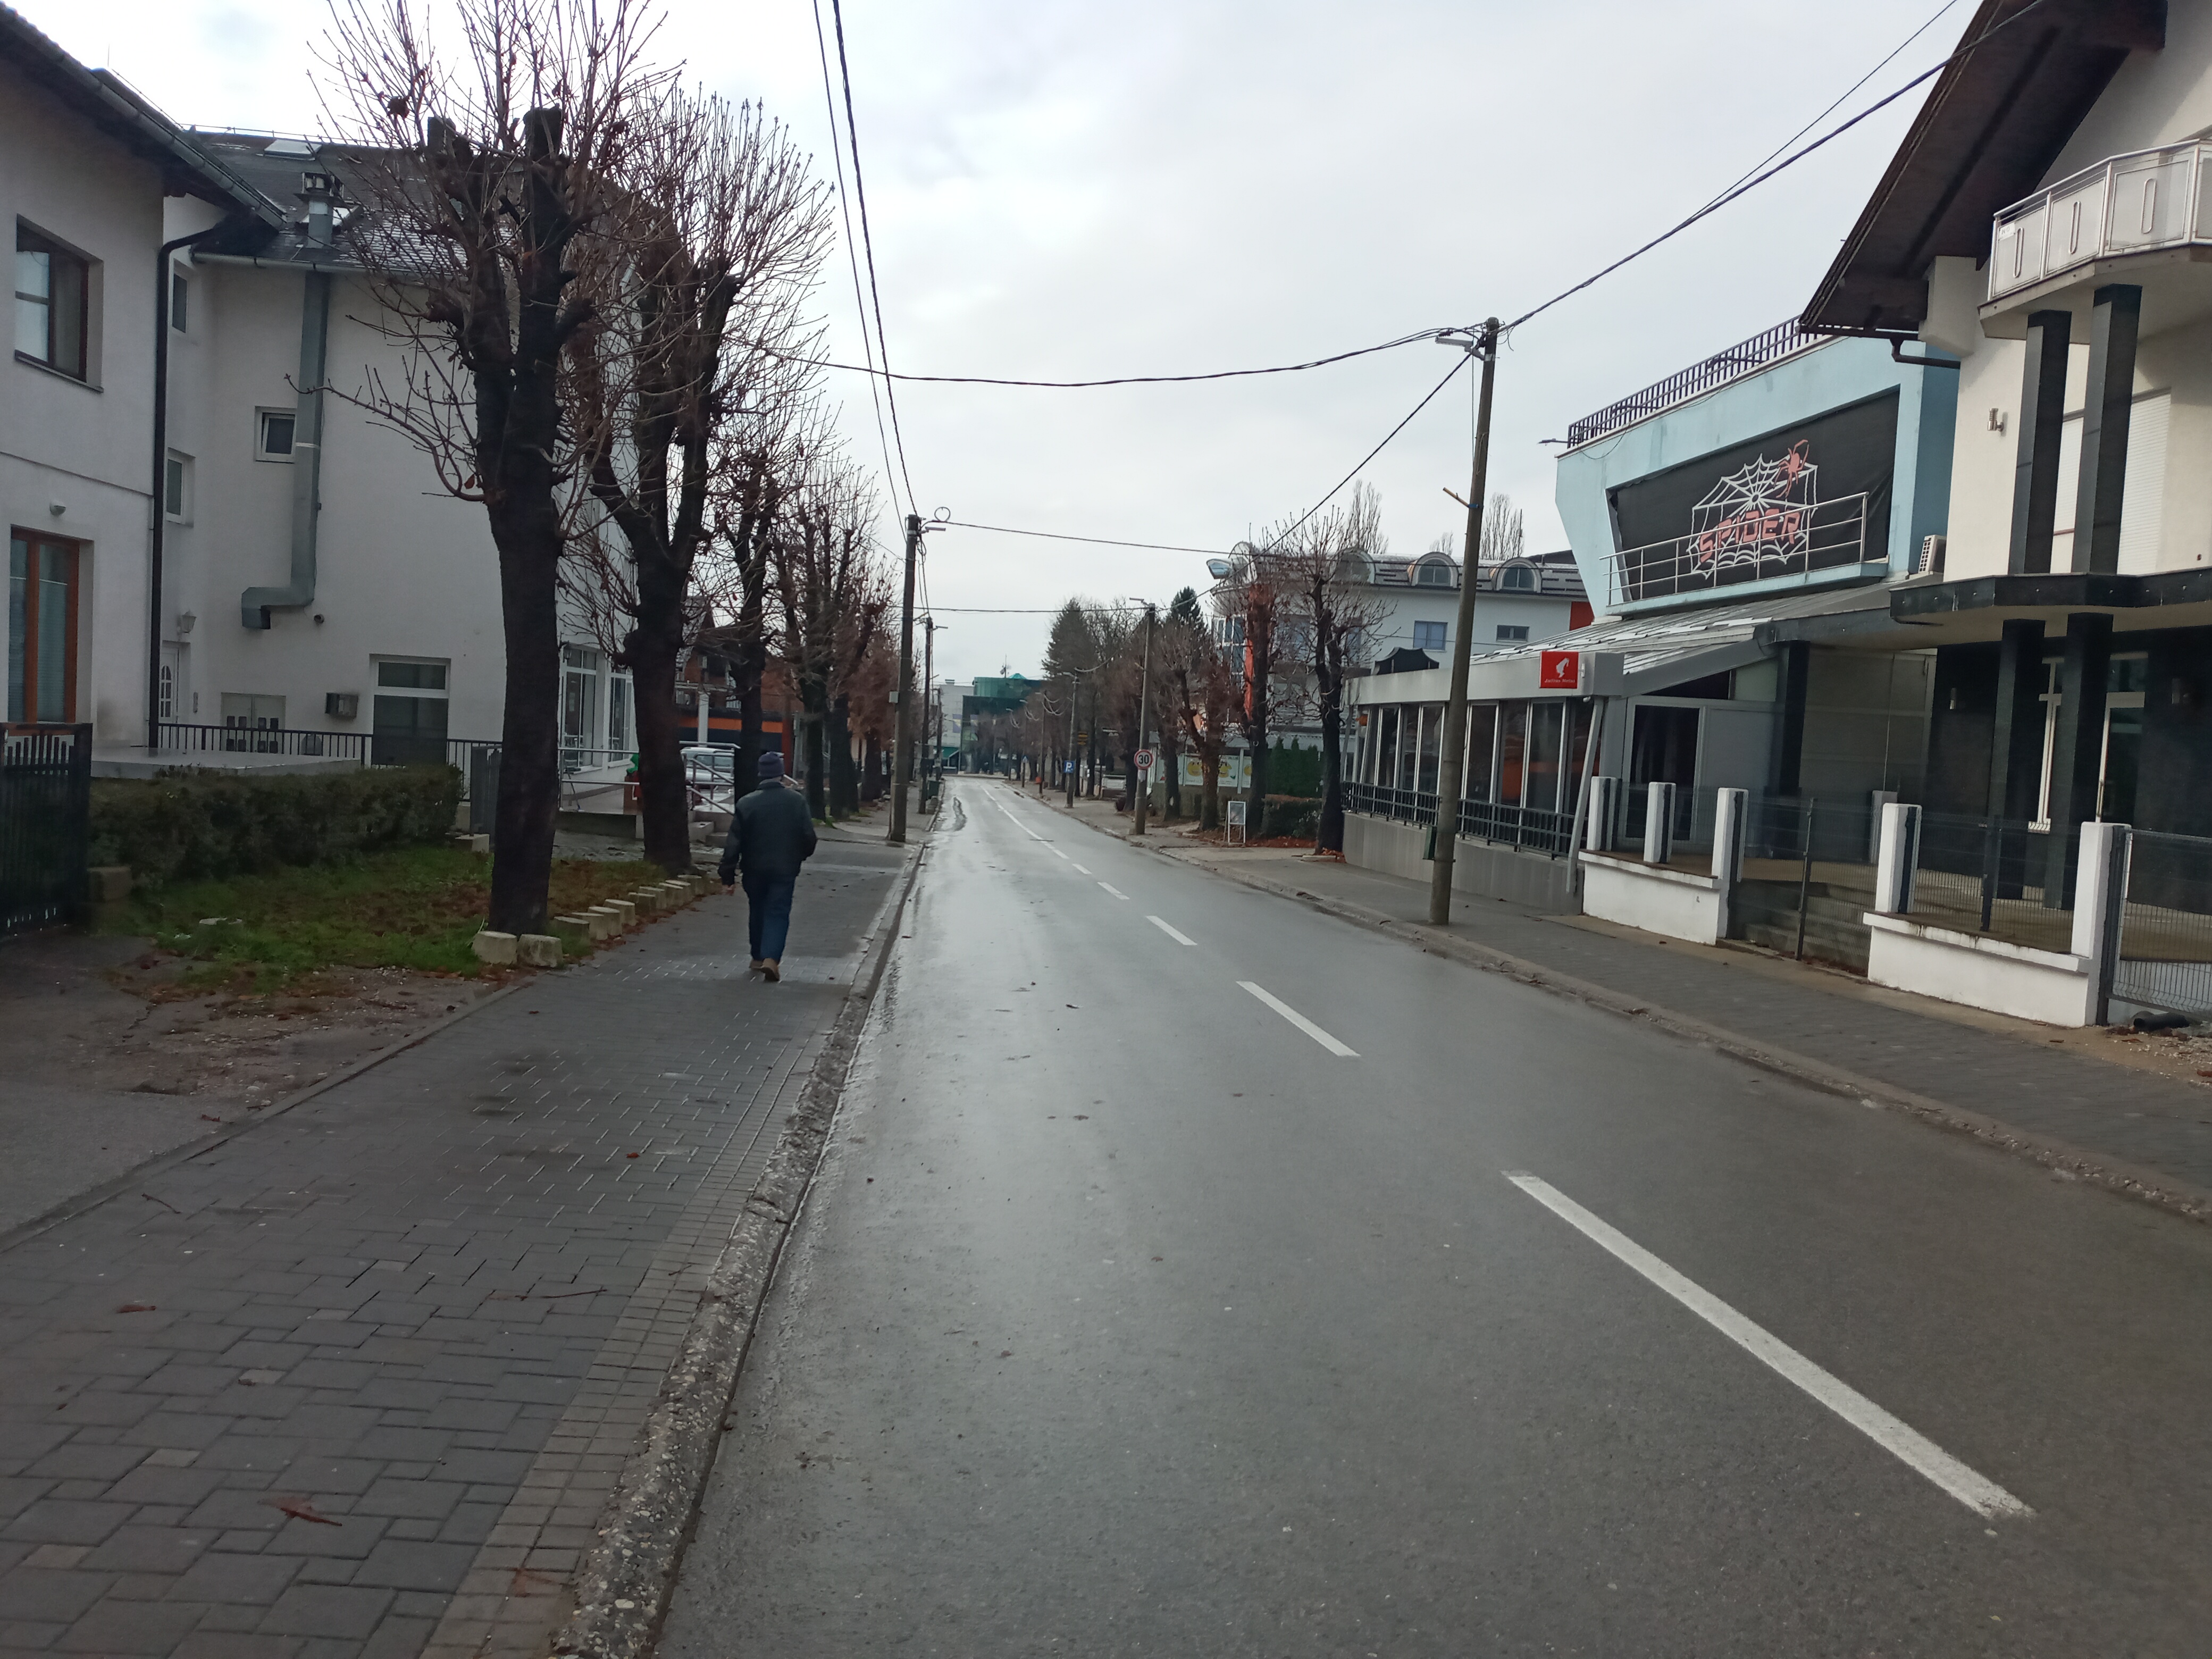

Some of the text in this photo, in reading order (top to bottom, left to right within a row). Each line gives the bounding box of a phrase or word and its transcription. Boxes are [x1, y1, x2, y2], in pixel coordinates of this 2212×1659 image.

[1699, 508, 1800, 563] SPIDER
[1138, 755, 1149, 764] 30
[1066, 762, 1072, 772] P
